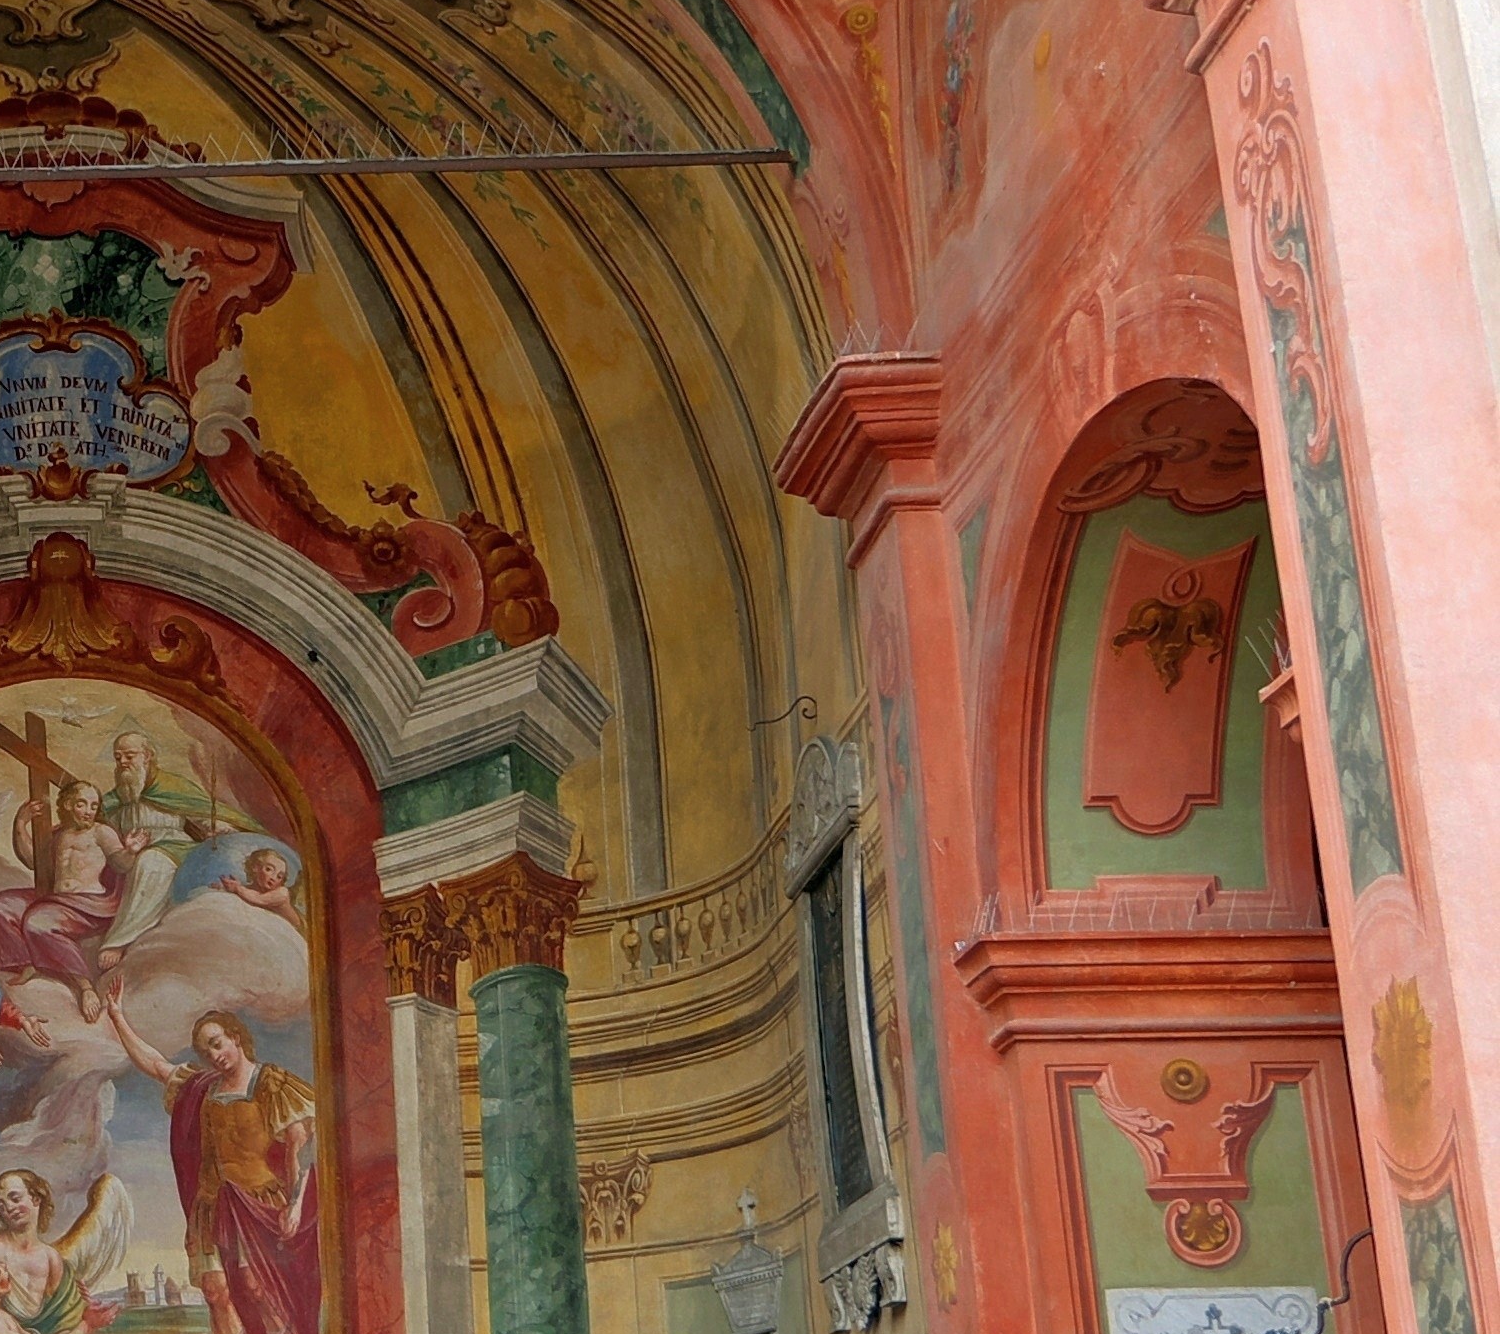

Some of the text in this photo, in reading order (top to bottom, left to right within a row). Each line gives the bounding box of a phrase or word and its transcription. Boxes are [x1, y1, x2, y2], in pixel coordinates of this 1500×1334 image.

[0, 376, 108, 394] VNVM DEVM
[80, 397, 100, 416] ET
[3, 419, 80, 443] VNITATE
